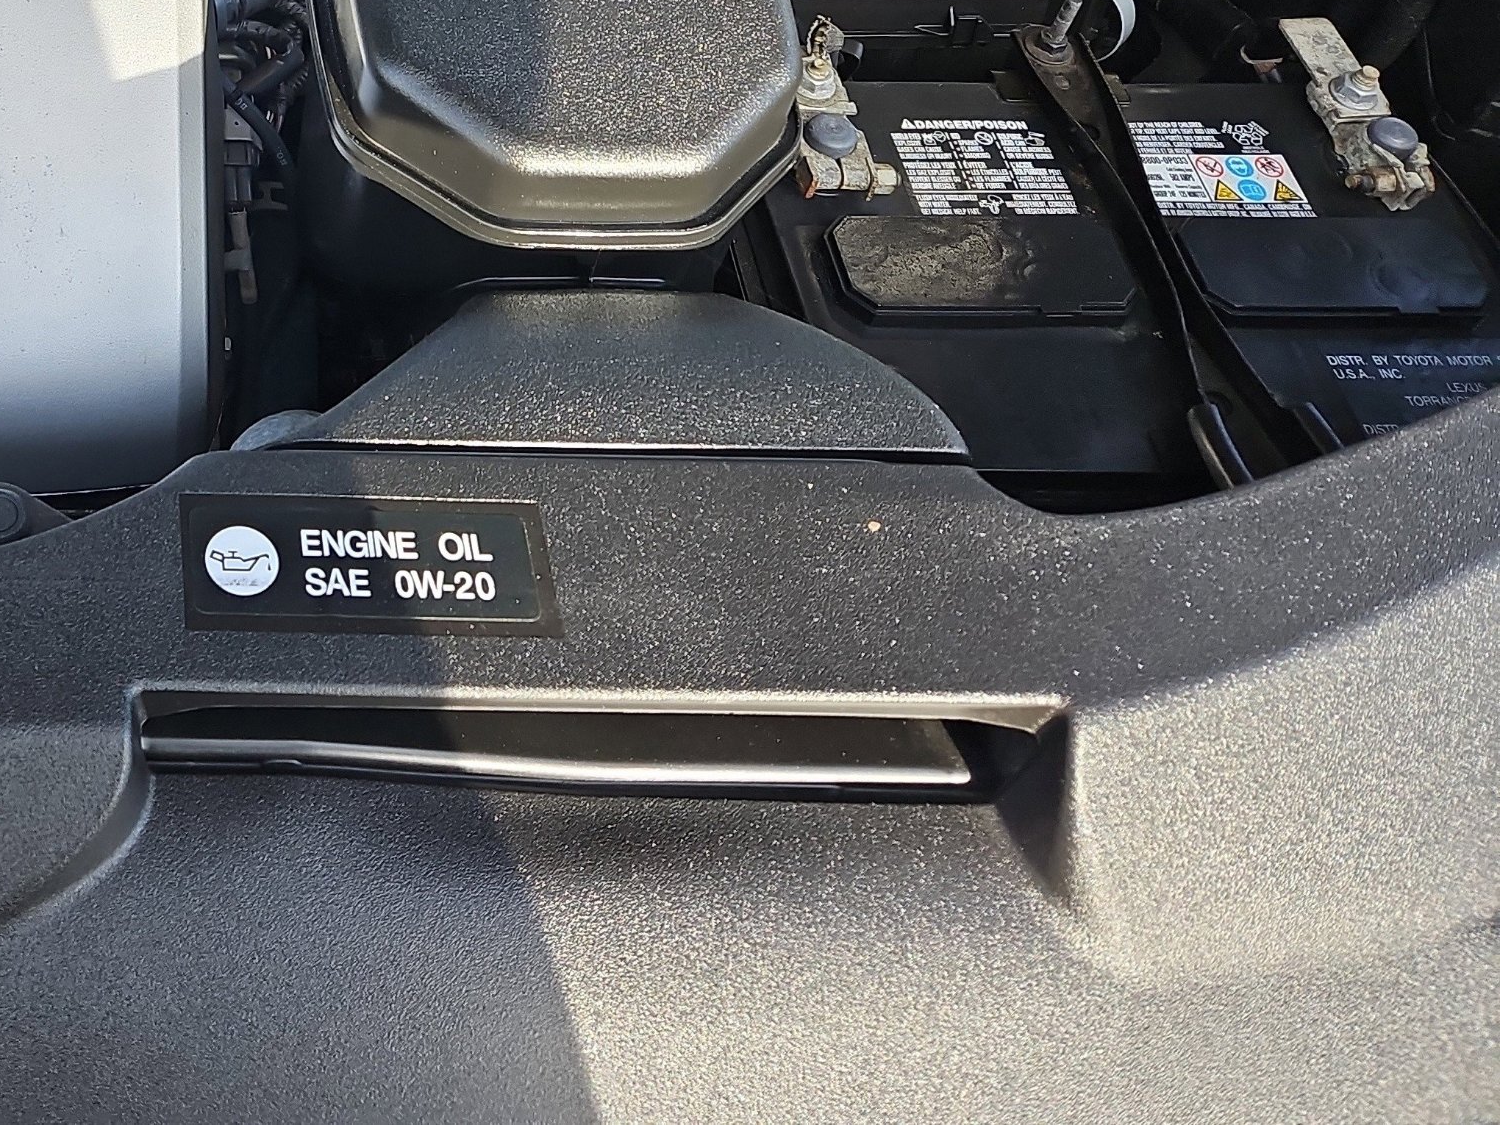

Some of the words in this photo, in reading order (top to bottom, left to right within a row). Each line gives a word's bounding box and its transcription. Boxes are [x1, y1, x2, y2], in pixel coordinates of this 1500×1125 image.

[913, 119, 1029, 130] DANGER/POISON
[1326, 355, 1368, 366] DISTR.
[1372, 356, 1389, 366] BY
[1393, 355, 1443, 366] TOYOTA
[1446, 356, 1493, 366] MOTOR
[1378, 369, 1406, 379] INC.
[300, 529, 418, 560] ENGINE
[437, 532, 494, 562] OIL
[304, 568, 371, 598] SAE
[394, 569, 496, 602] 0W-20
